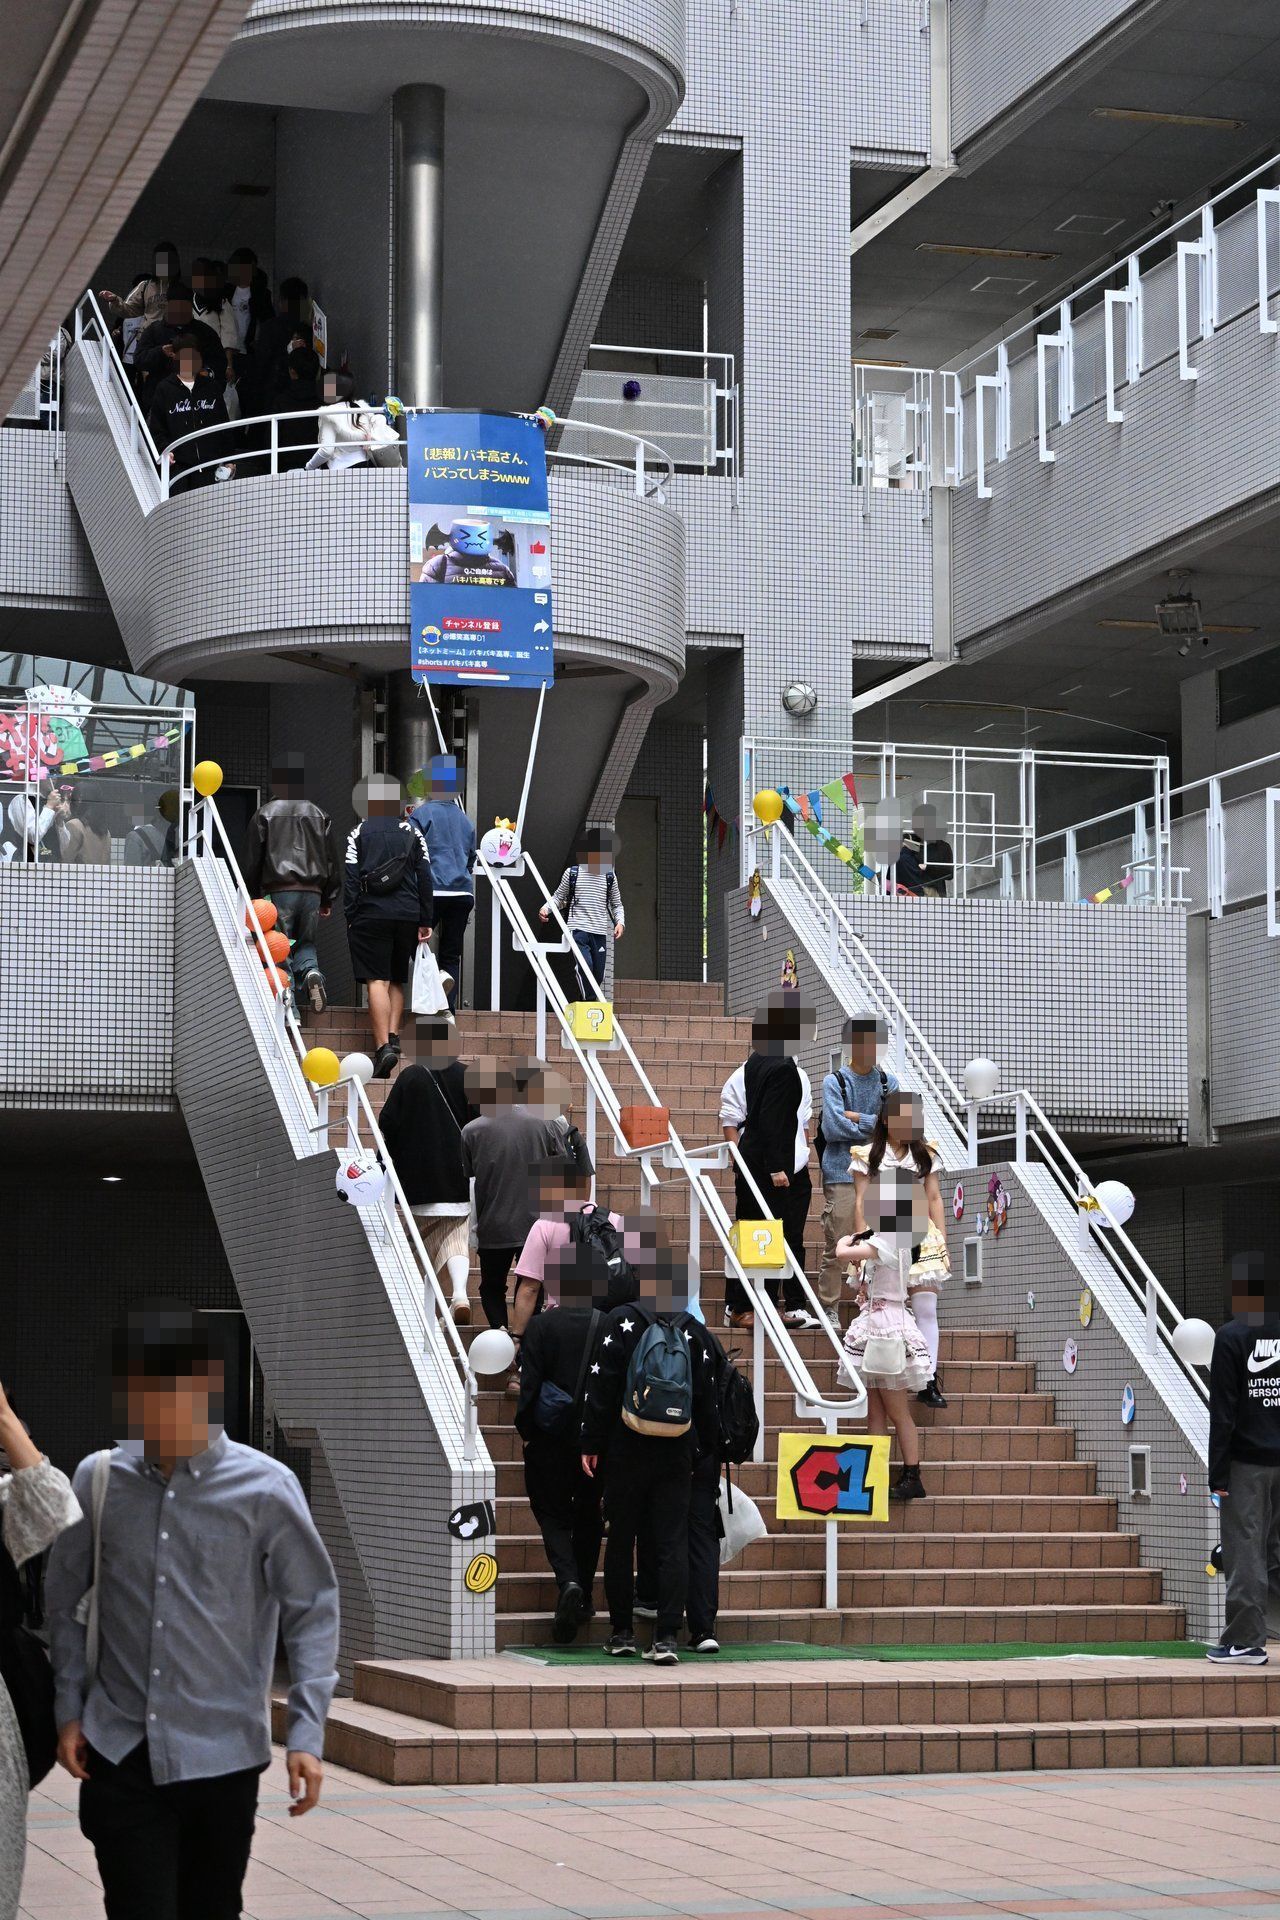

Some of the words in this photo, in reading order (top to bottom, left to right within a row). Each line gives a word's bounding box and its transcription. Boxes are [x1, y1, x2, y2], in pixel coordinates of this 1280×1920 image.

[424, 447, 529, 465] 【悲報】バキ高さん、
[424, 468, 530, 485] バズってしまうwww
[445, 619, 500, 630] チャンネル登録
